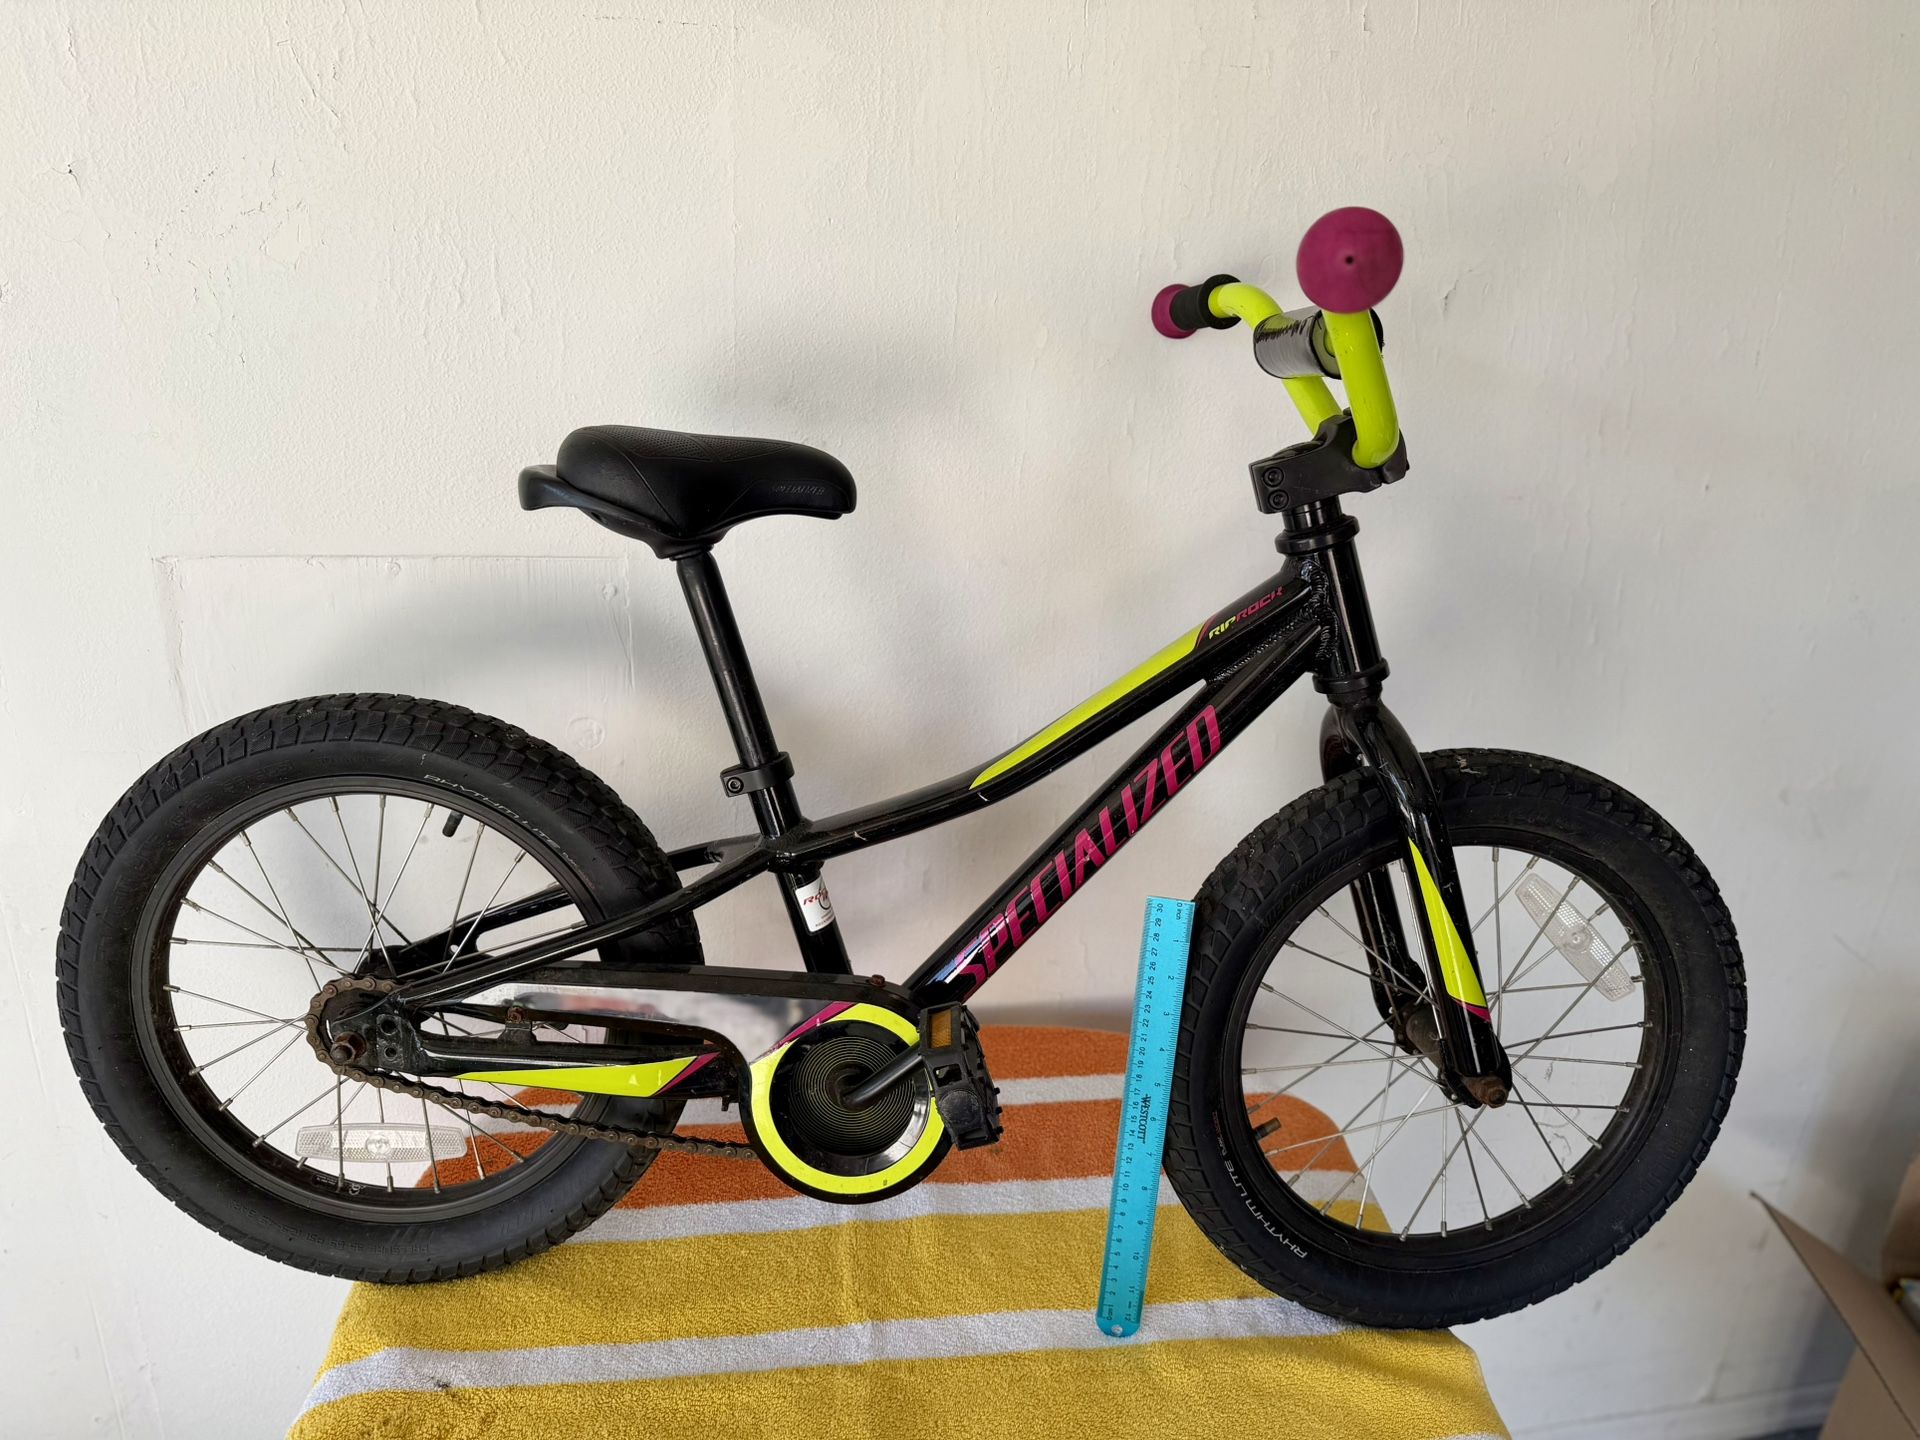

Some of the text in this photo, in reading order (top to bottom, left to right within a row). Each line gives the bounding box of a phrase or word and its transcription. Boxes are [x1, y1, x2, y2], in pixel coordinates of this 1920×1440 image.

[1208, 586, 1285, 640] RIPROCK
[954, 704, 1222, 1003] SPECIALIZED
[1157, 903, 1164, 913] 30
[1155, 918, 1162, 927] 29
[1153, 933, 1160, 942] 28
[1151, 947, 1158, 957] 27
[1149, 961, 1156, 971] 26
[1147, 976, 1155, 985] 25
[1146, 990, 1152, 999] 24
[1144, 1005, 1151, 1014] 23
[1142, 1018, 1149, 1028] 22
[1141, 1033, 1147, 1042] 21
[1139, 1046, 1146, 1056] 20
[1137, 1060, 1144, 1068] 19
[1136, 1074, 1143, 1082] 18
[1133, 1101, 1139, 1110] 16
[1131, 1115, 1137, 1123] 15
[1137, 1093, 1152, 1144] WESTCOTT
[1126, 1156, 1133, 1164] 12
[1122, 1183, 1129, 1191] 10
[1223, 1160, 1308, 1258] RHYTHM LITE
